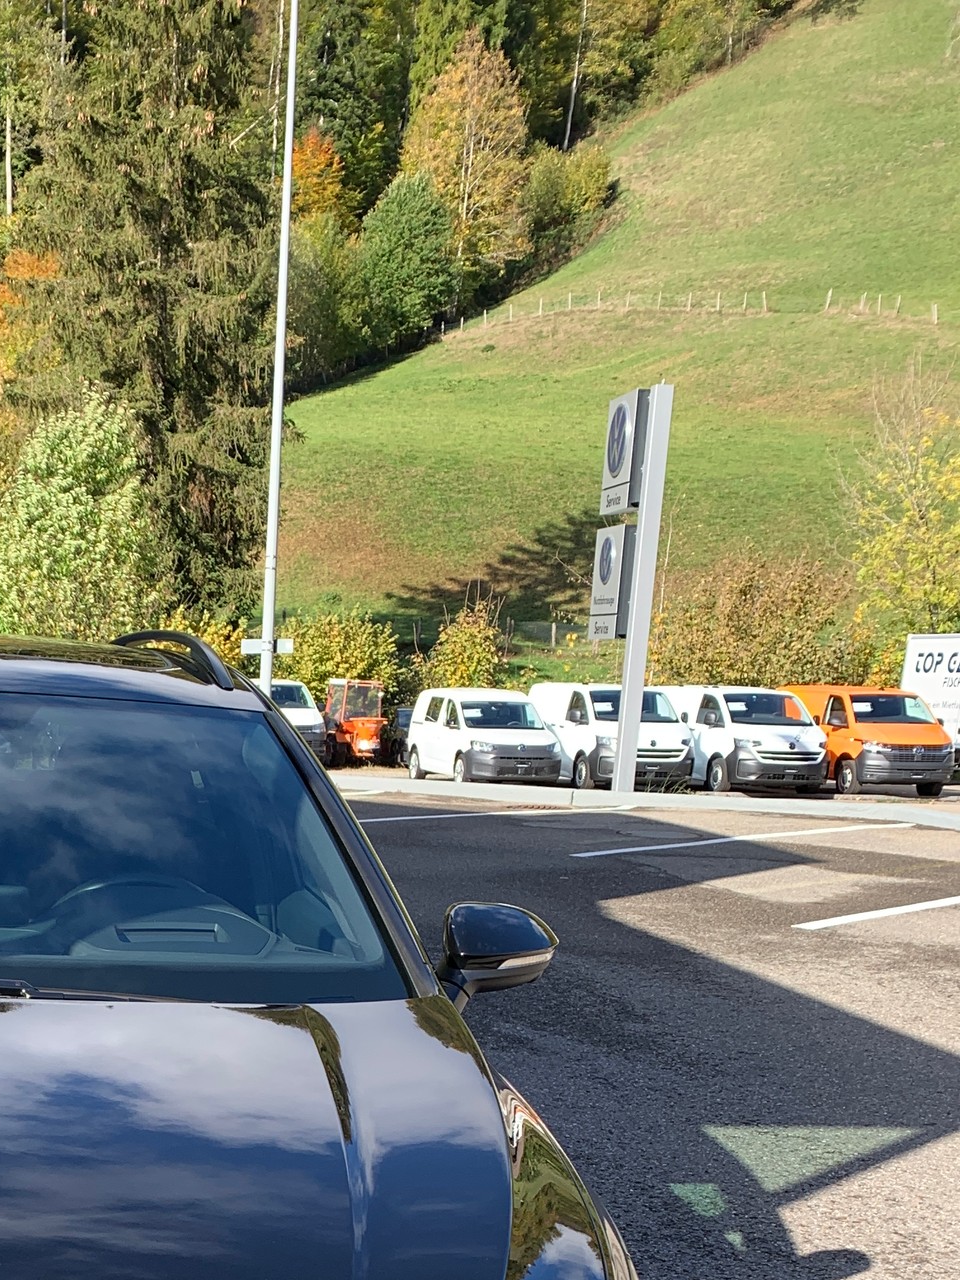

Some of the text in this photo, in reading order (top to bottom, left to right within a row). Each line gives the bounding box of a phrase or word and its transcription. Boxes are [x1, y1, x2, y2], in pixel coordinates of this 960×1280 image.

[606, 493, 621, 508] Service
[594, 621, 609, 634] Service
[915, 652, 944, 673] TOP
